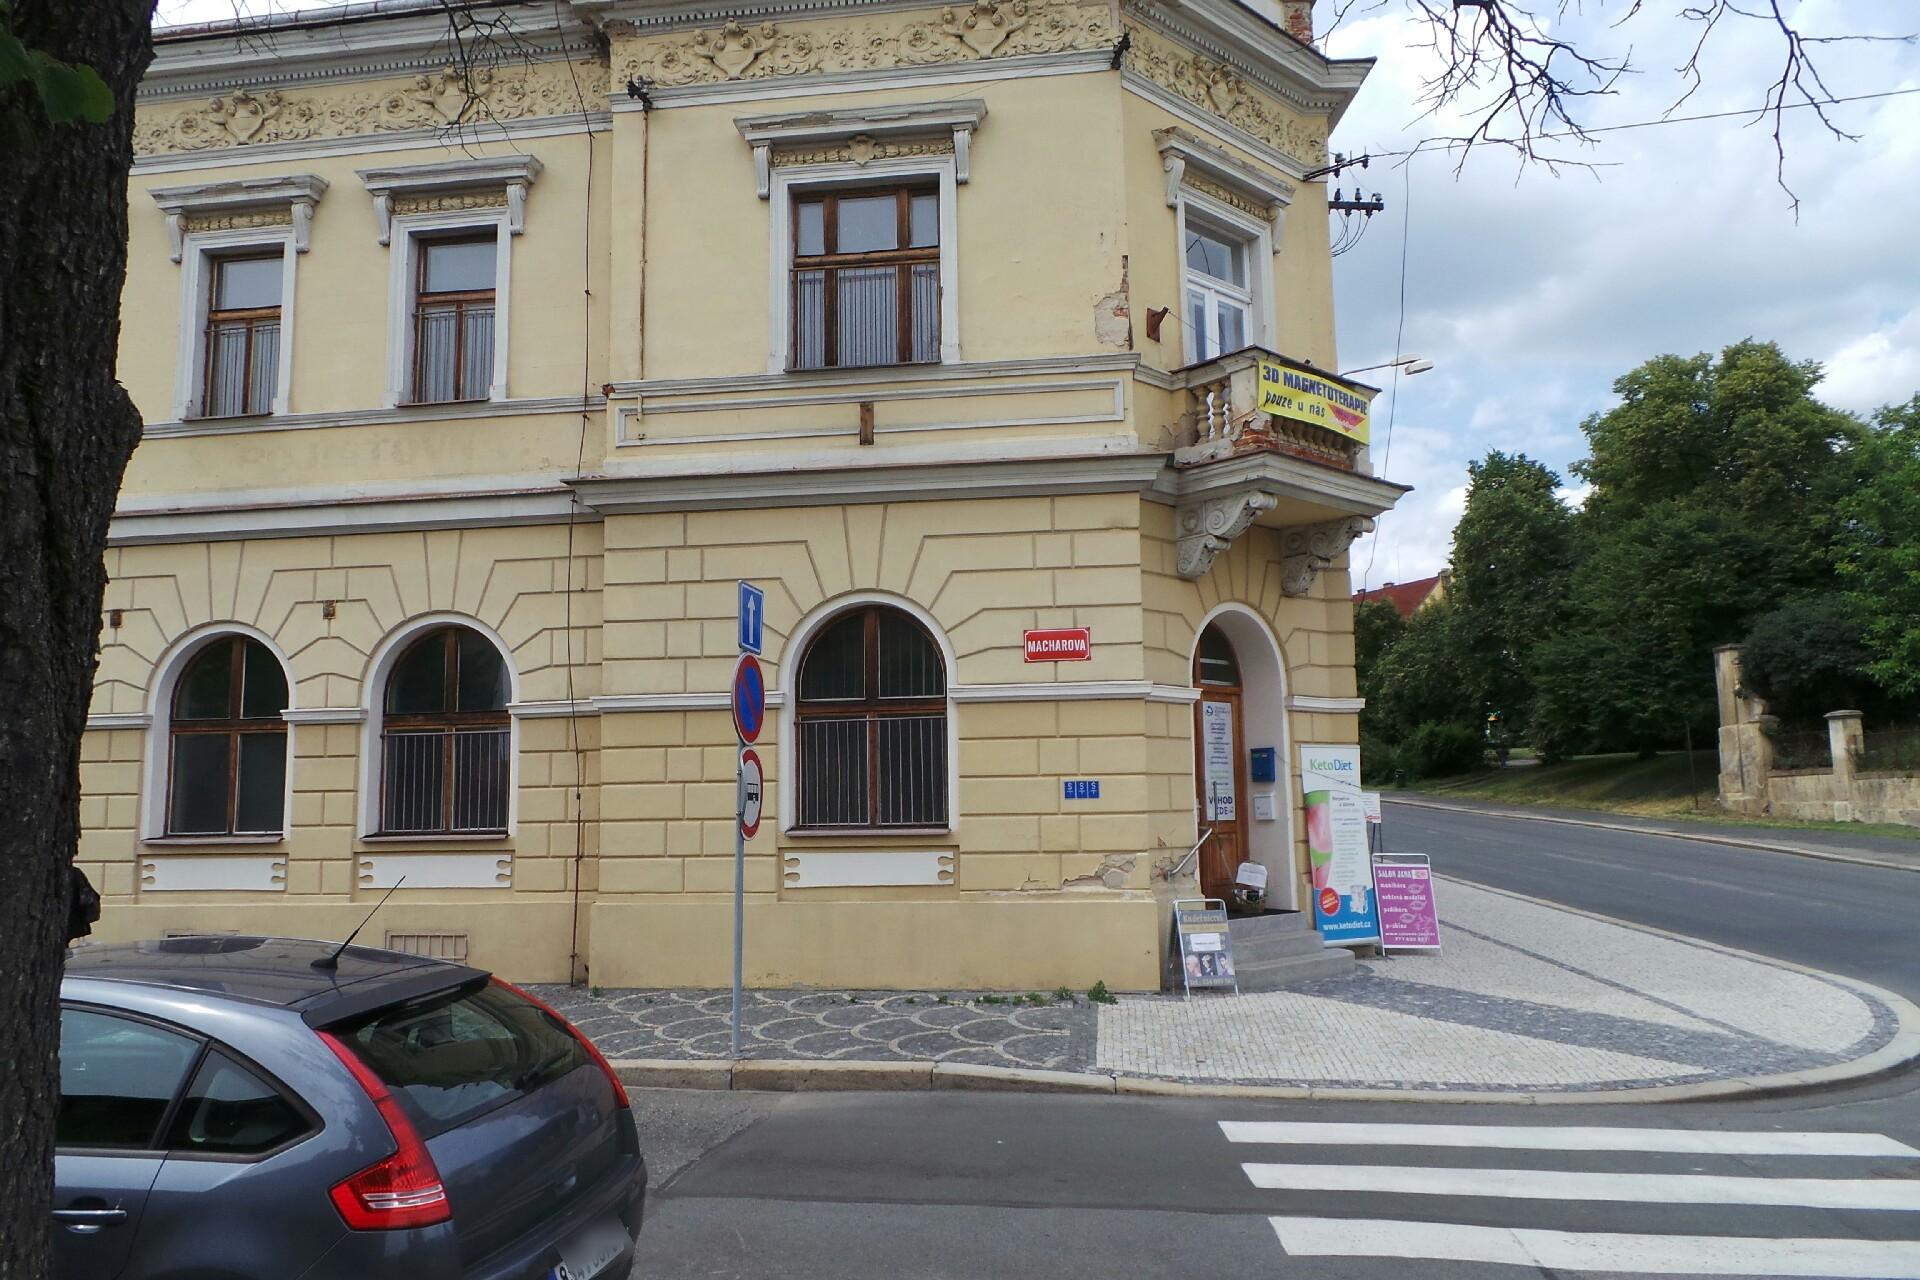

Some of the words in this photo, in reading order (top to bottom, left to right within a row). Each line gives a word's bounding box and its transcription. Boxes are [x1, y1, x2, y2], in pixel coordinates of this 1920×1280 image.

[1263, 365, 1280, 384] 3D
[1283, 371, 1368, 415] MAGNETOTERAPIE
[1264, 390, 1293, 409] pouze
[1298, 402, 1304, 411] u
[1309, 401, 1326, 417] nás
[1028, 639, 1087, 653] MACHAROVA
[1309, 758, 1353, 771] KetoDiet
[1208, 796, 1233, 805] VHOD
[1378, 870, 1396, 878] SALON
[1322, 920, 1372, 931] www.ketodiet.cz
